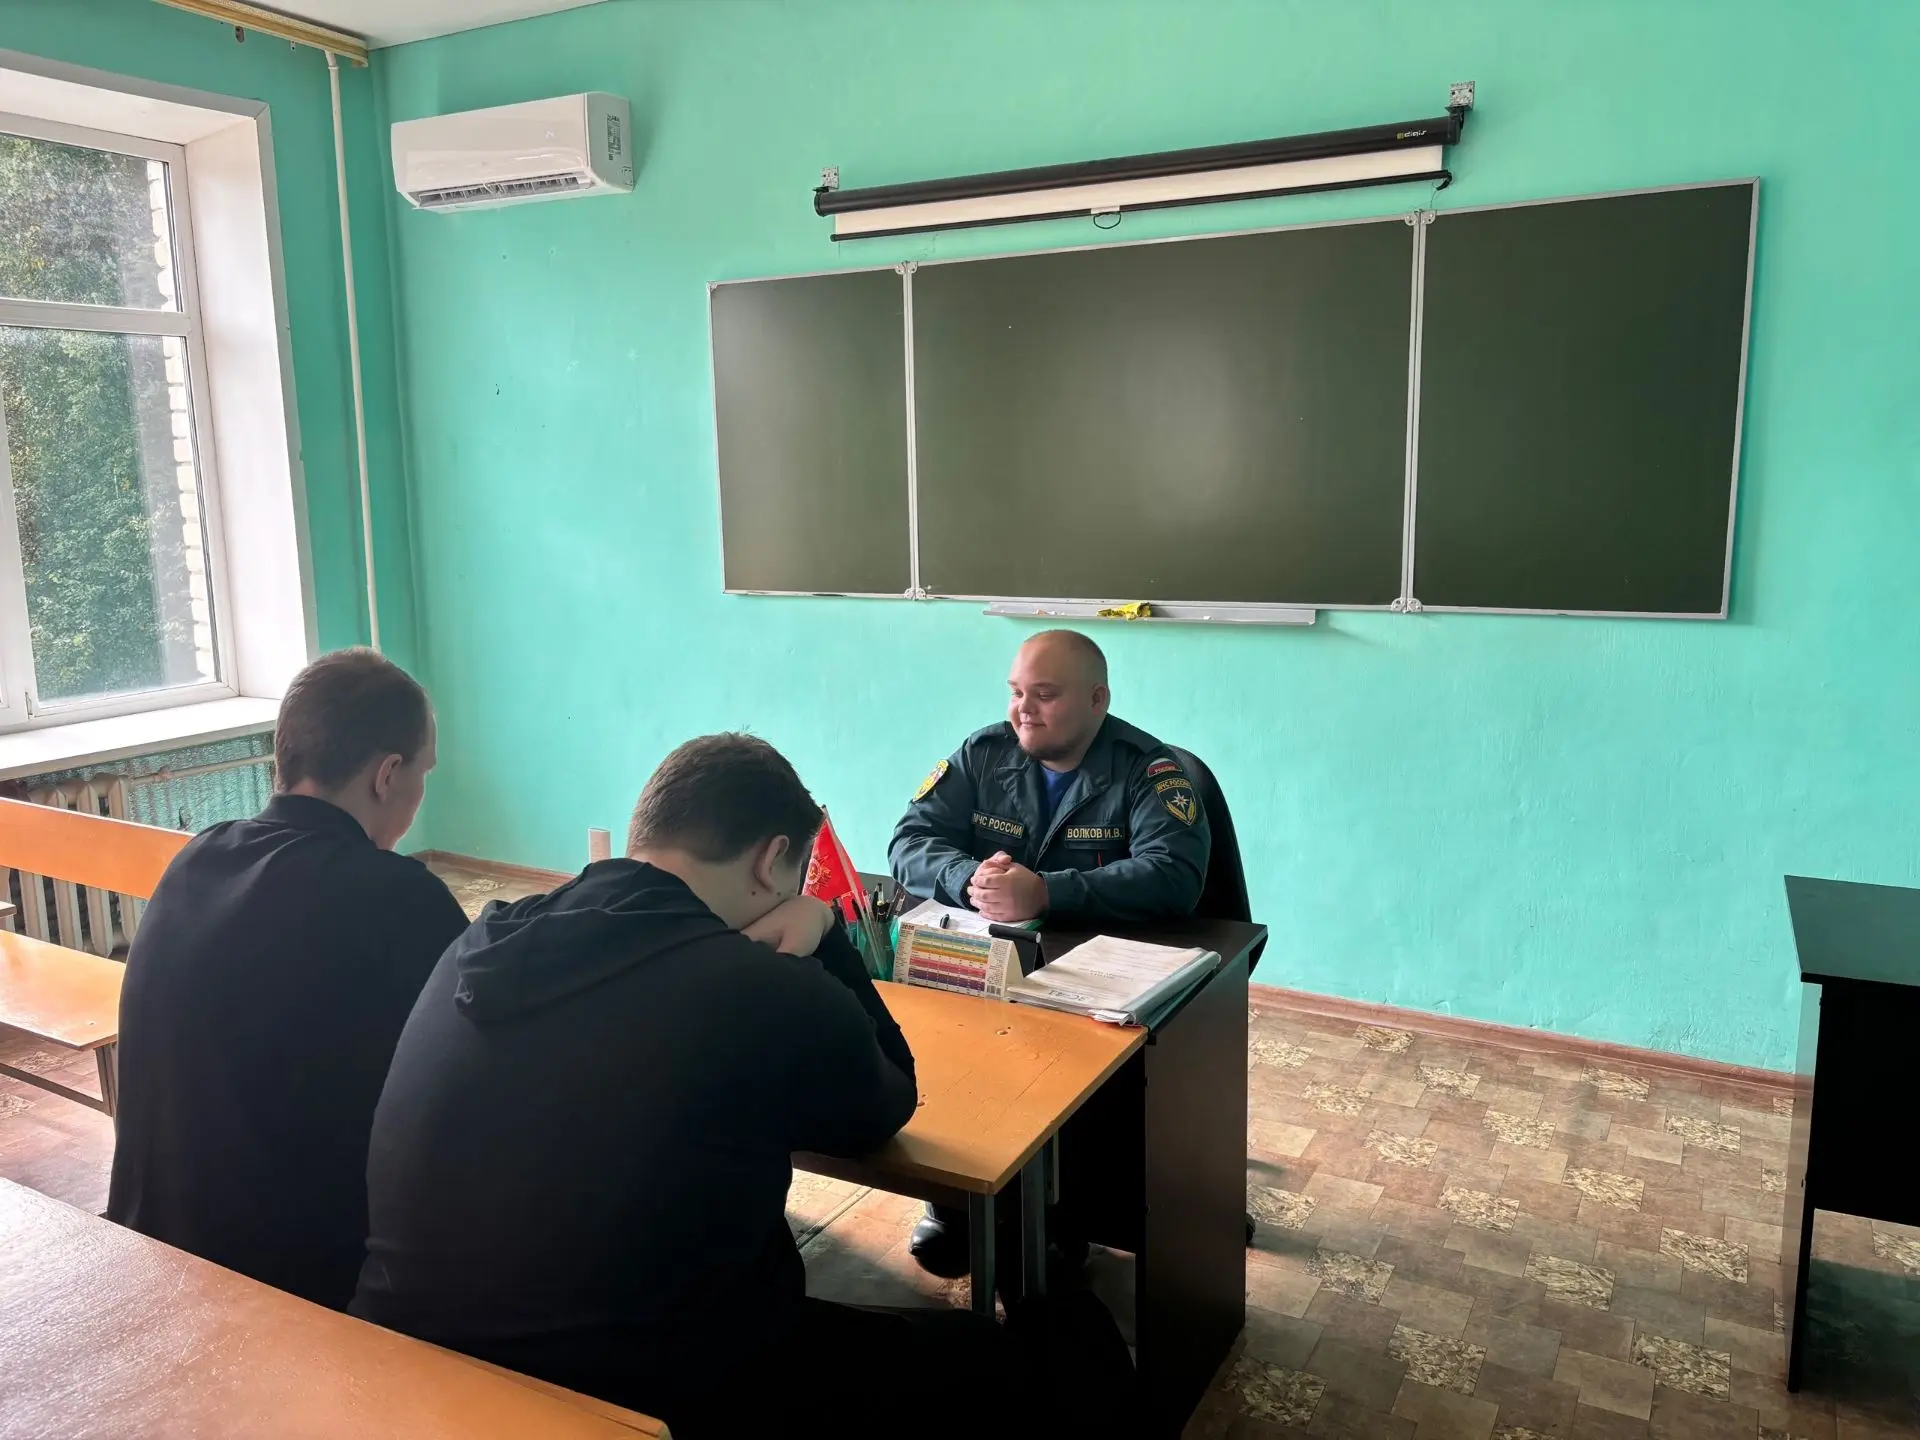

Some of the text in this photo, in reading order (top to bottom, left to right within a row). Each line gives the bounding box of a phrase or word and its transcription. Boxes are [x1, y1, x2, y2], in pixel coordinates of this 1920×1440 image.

[972, 812, 1022, 836] МЧС РОССИИ
[1067, 828, 1123, 838] ВОЛКОВ И.В.
